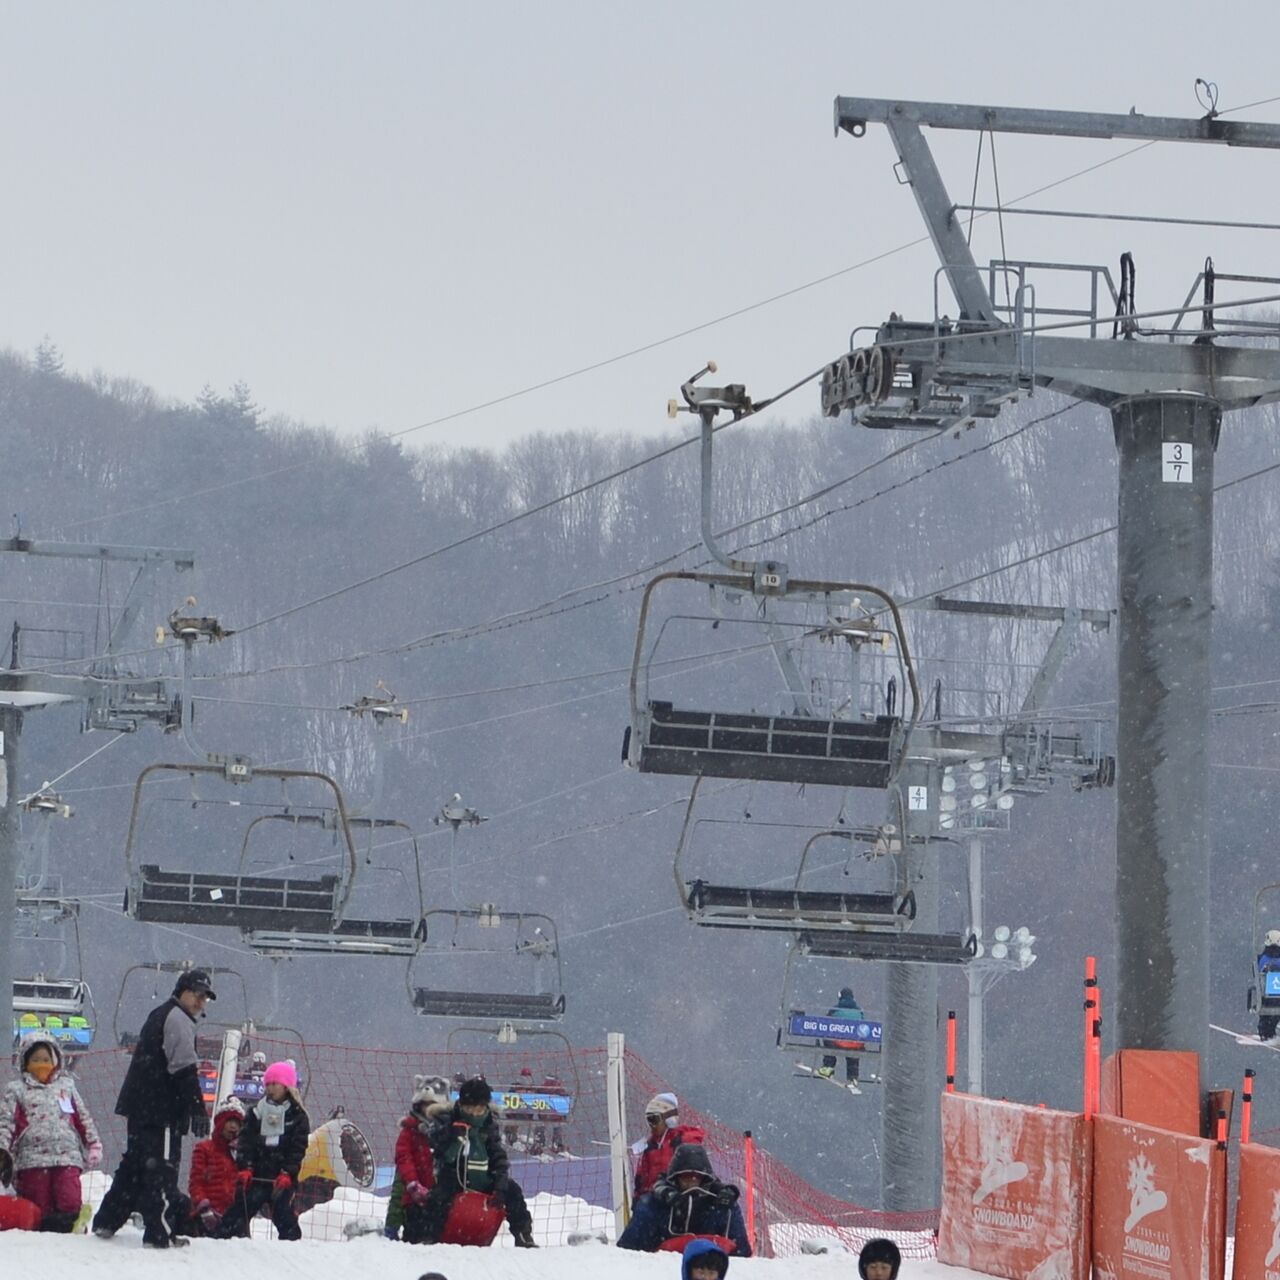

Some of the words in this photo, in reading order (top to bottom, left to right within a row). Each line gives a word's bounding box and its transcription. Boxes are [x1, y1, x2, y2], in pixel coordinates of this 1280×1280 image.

[1173, 444, 1183, 461] 3
[1173, 464, 1183, 481] 7
[765, 575, 777, 584] 10
[803, 1021, 817, 1030] BIG
[819, 1023, 827, 1031] to
[829, 1024, 855, 1034] GREAT
[973, 1207, 1034, 1230] SNOWBOARD
[1123, 1235, 1170, 1261] SNOWBOARD
